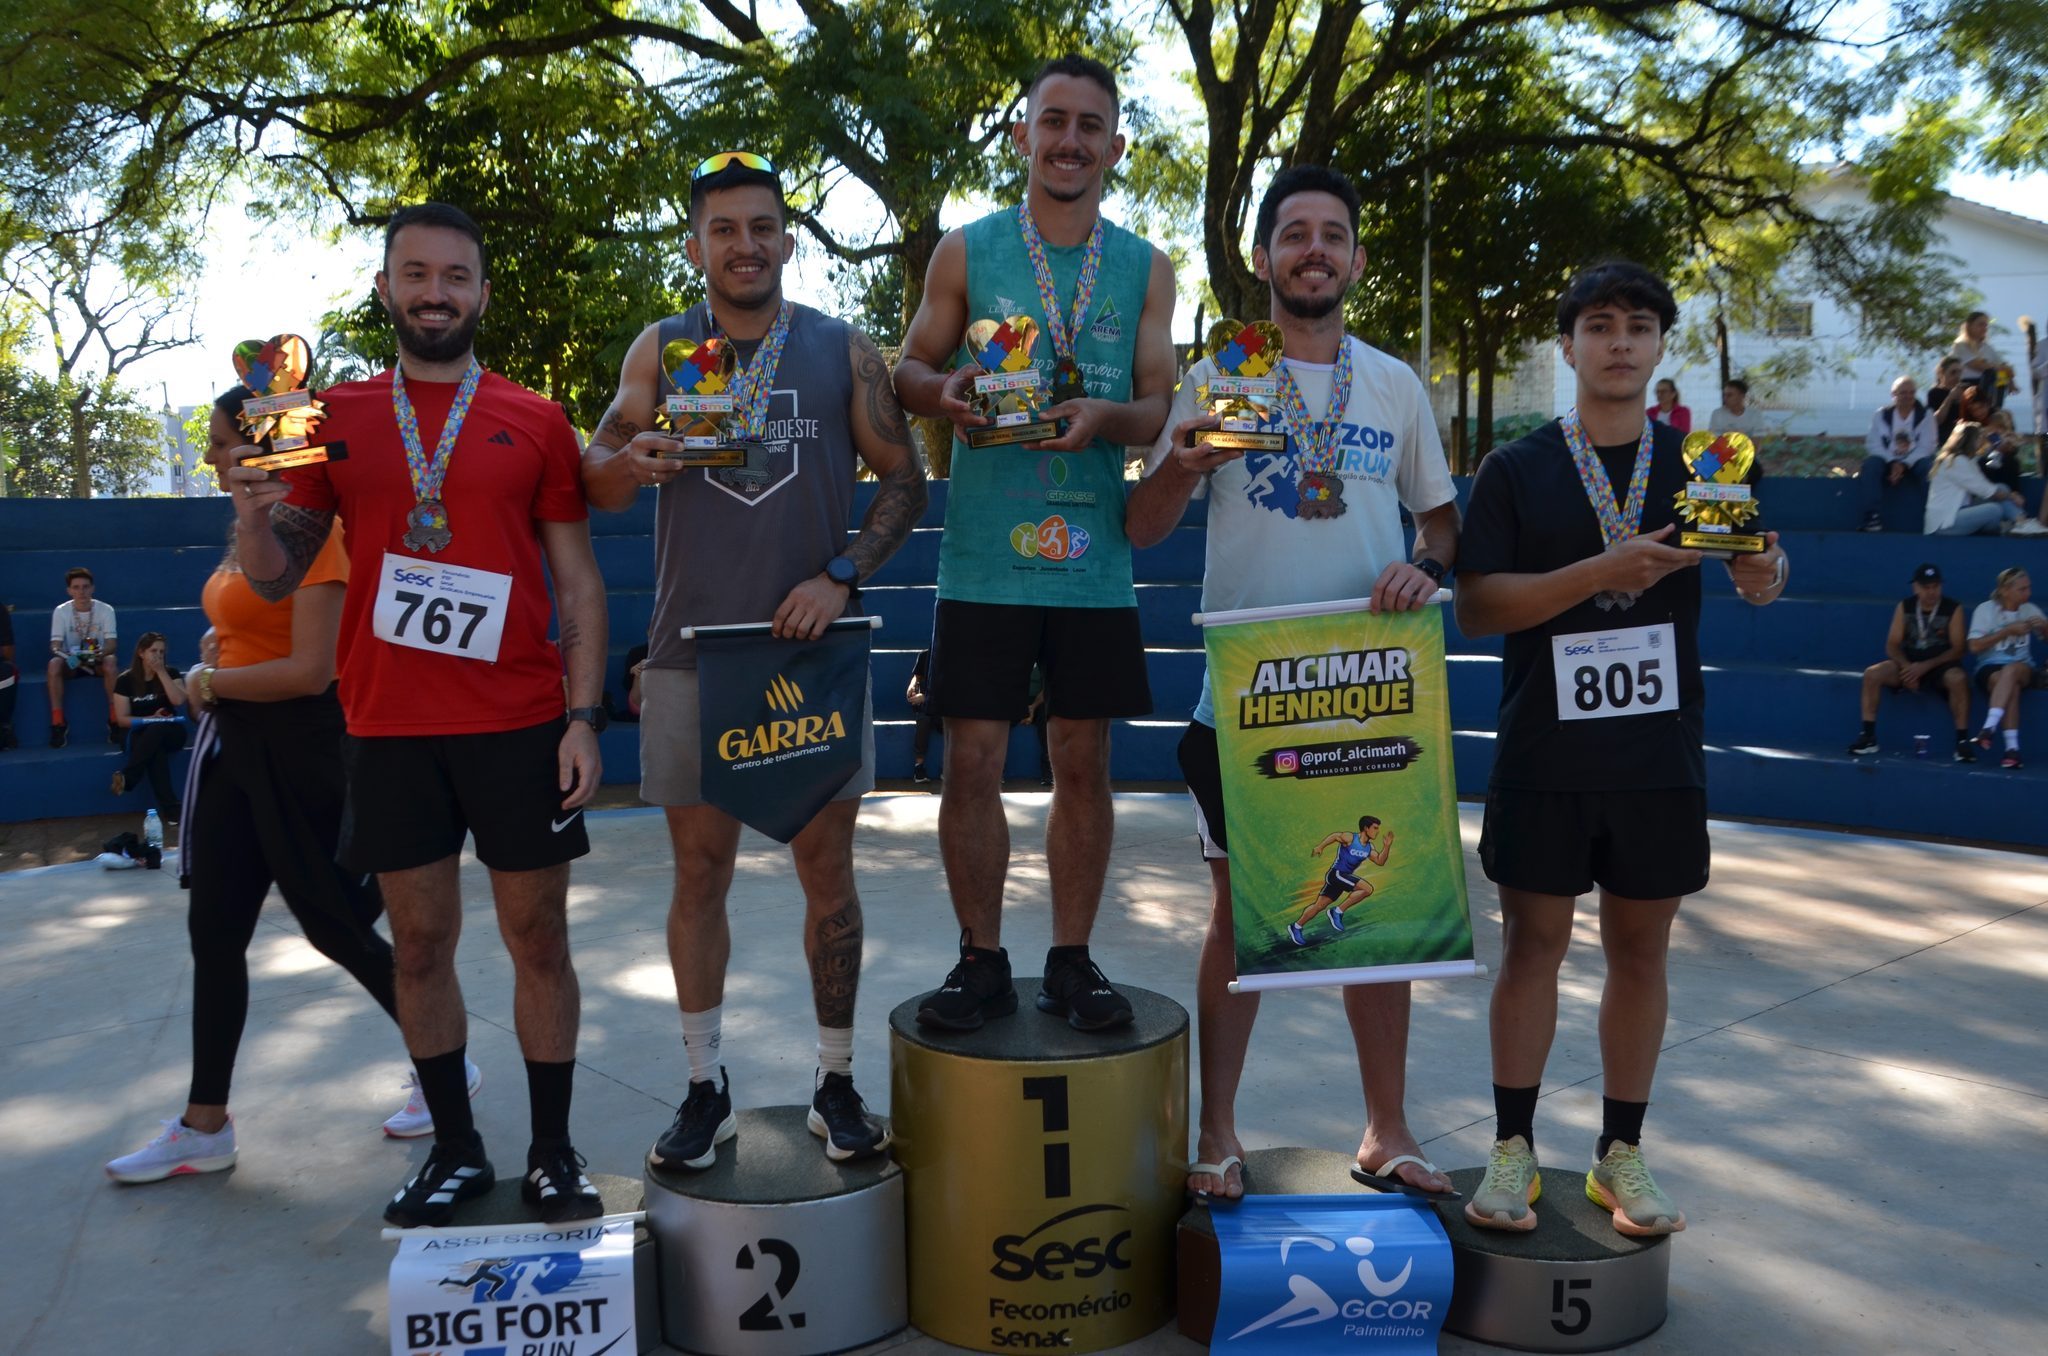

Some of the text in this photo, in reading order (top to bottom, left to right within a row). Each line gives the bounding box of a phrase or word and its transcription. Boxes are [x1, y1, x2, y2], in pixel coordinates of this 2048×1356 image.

[1090, 324, 1121, 337] ARENA
[979, 378, 1039, 392] Autismo
[1212, 384, 1275, 394] Autismo
[670, 403, 731, 411] Autismo
[1689, 490, 1749, 500] Autismo
[394, 589, 488, 650] 767
[1253, 649, 1408, 694] ALCIMAR
[1574, 658, 1663, 711] 805
[1243, 681, 1409, 725] HENRIQUE
[718, 710, 846, 762] GARRA
[732, 744, 831, 771] centro de treinamento
[1301, 742, 1407, 766] @prof_alcimarh
[1305, 766, 1350, 776] TREINADOR
[1366, 762, 1402, 771] CORRIDA
[1023, 1075, 1071, 1199] 1
[422, 1224, 612, 1252] ASSESSORIA
[736, 1238, 806, 1331] 2
[989, 1290, 1132, 1321] Fecomércio
[1341, 1299, 1432, 1321] GCOR
[1550, 1279, 1592, 1336] 5
[406, 1297, 608, 1349] BIG FORT
[1343, 1323, 1425, 1338] Palmitinho
[521, 1340, 575, 1356] RUN
[991, 1326, 1070, 1349] Senac
